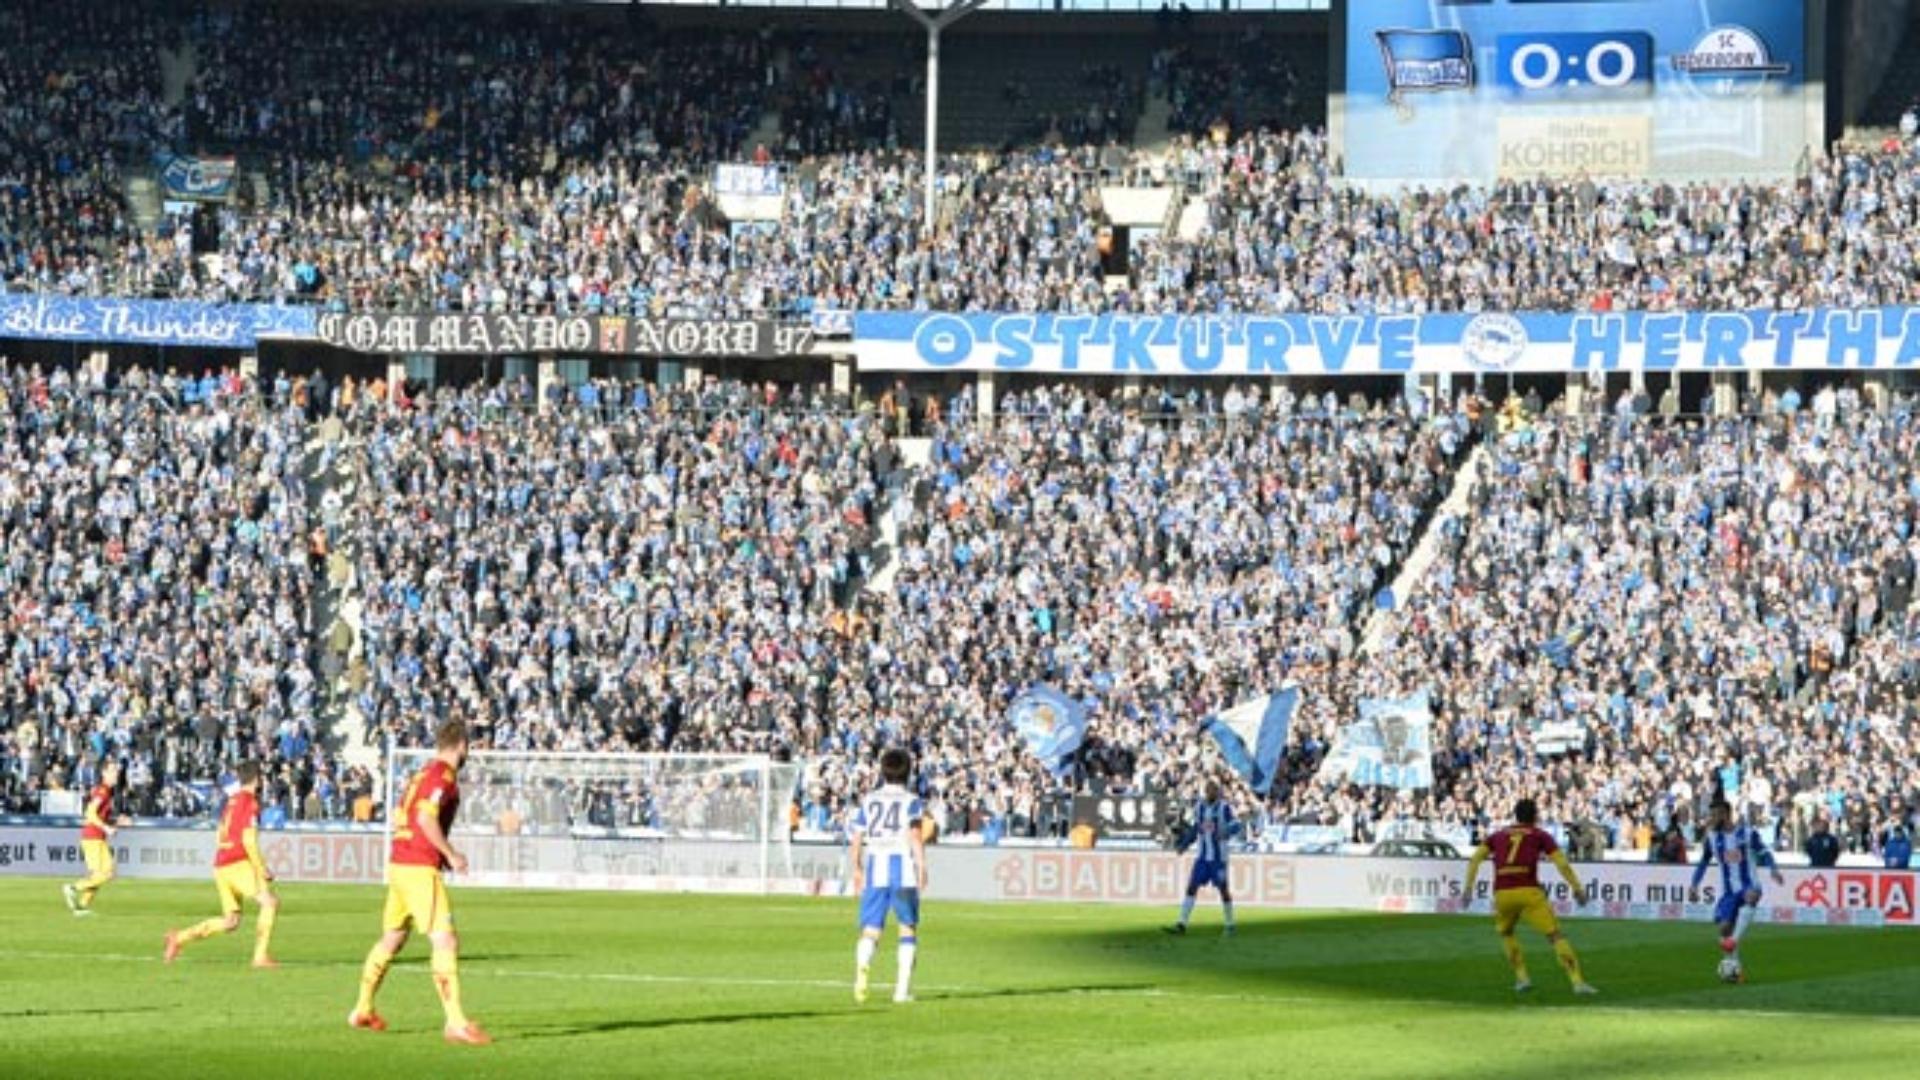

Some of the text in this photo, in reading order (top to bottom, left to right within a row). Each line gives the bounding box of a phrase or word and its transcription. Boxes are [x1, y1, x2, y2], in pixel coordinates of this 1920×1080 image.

[3, 301, 87, 336] Blue
[96, 305, 242, 341] Thunder
[318, 313, 592, 352] COMMANDO
[635, 318, 759, 354] NORD
[914, 314, 1418, 372] OSTKURVE
[868, 801, 901, 838] 24
[47, 845, 129, 863] wen
[1506, 832, 1524, 865] 7
[1036, 856, 1292, 898] BAUHUS
[1367, 873, 1461, 897] Wenn's
[1540, 878, 1632, 902] weden
[1647, 885, 1716, 904] mus
